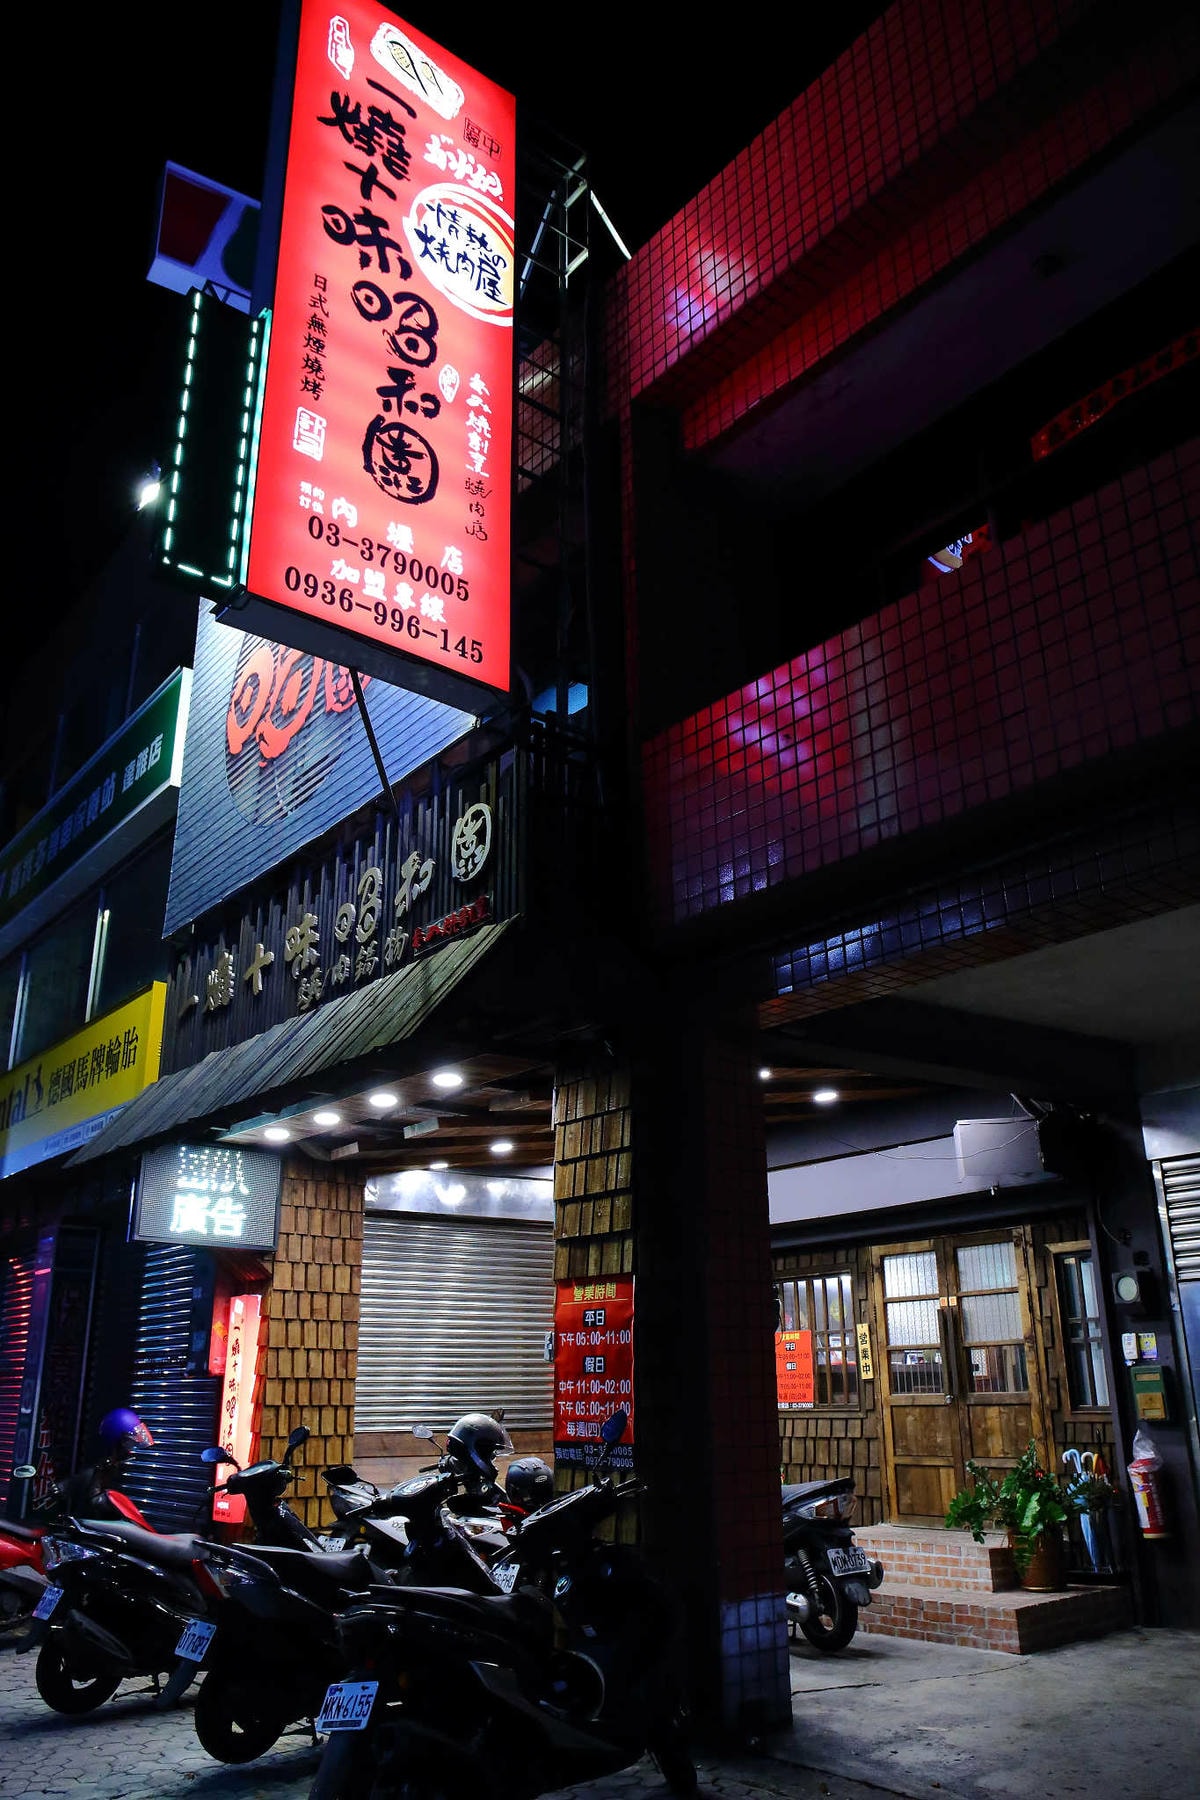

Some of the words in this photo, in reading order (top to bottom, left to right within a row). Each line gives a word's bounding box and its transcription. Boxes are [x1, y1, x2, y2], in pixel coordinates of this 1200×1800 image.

[300, 273, 330, 402] 日式無煙燒烤
[308, 515, 469, 602] 03-3790005
[285, 566, 484, 663] 0936-996-145
[48, 1027, 138, 1107] 德國馬牌輪胎
[573, 1283, 616, 1302] 營業時間
[584, 1310, 605, 1326] 平日
[559, 1332, 574, 1346] 下午
[576, 1329, 631, 1346] 05:00~11:00
[584, 1356, 605, 1373] 假日
[559, 1381, 574, 1395] 中午
[576, 1379, 631, 1395] 11:00~02:00
[558, 1401, 574, 1416] 下午
[321, 1694, 374, 1720] MKN-6155
